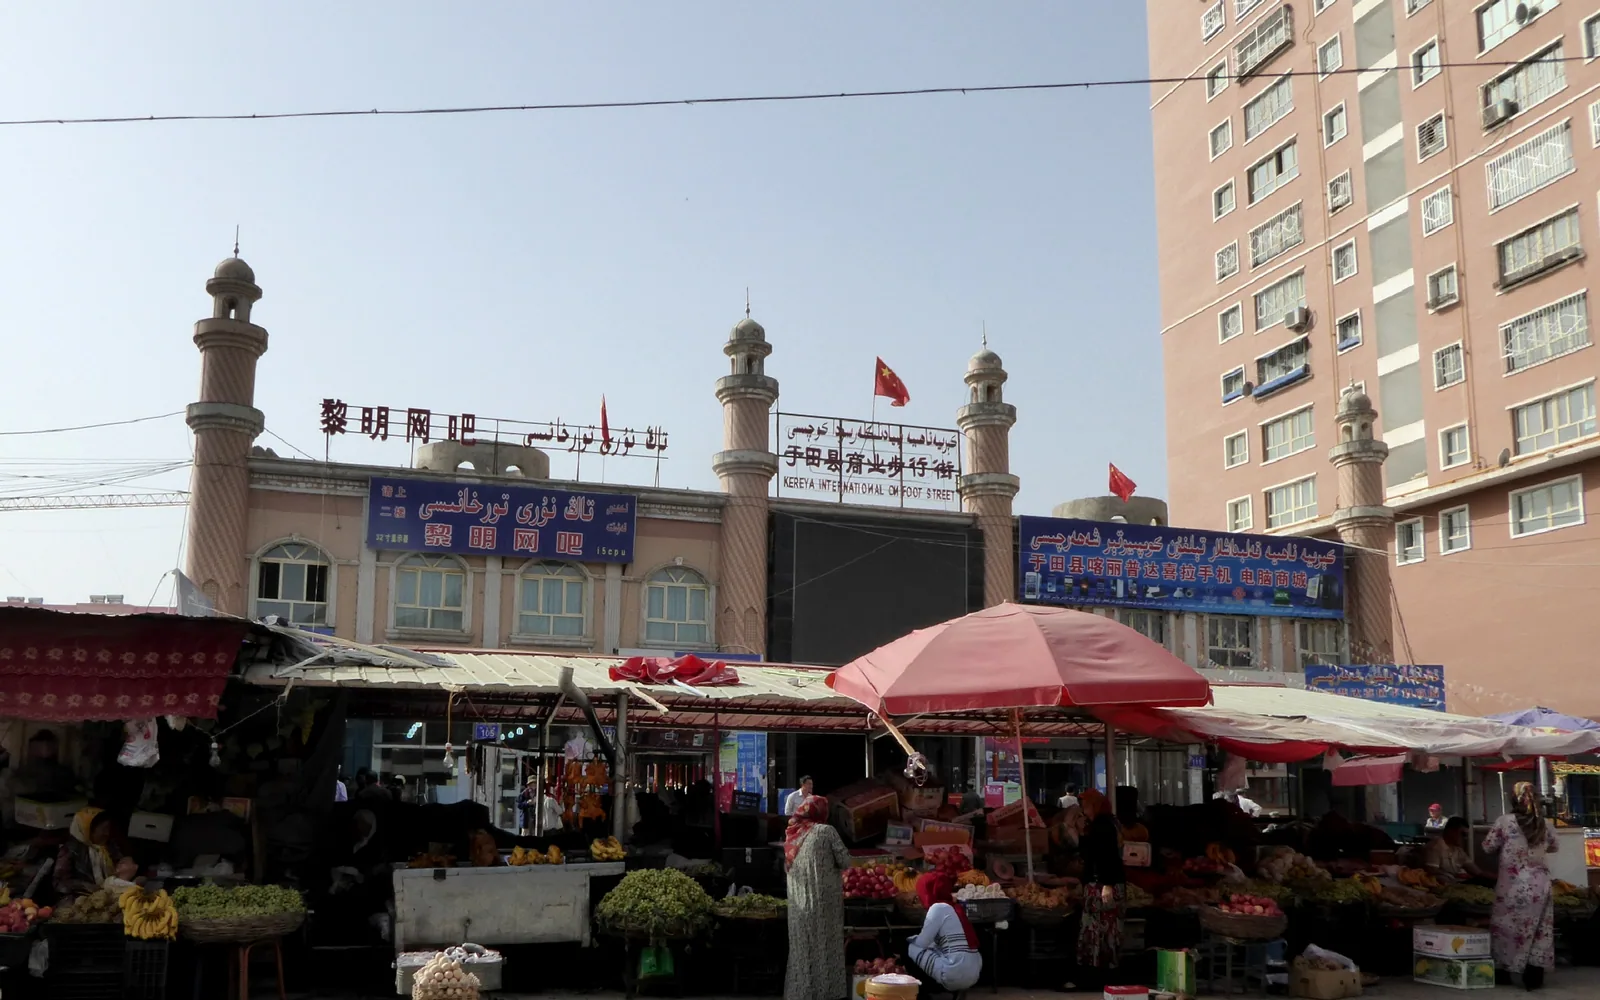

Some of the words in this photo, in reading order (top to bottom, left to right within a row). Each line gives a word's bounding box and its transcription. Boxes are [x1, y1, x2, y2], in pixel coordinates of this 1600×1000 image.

[321, 398, 476, 446] 黎明网吧
[784, 445, 955, 480] 于田县商业步行街
[419, 487, 510, 525] تورخانىسى
[783, 476, 815, 490] KEREYA
[819, 478, 884, 496] INTERNATIONAL
[902, 486, 922, 498] FOOT
[926, 488, 955, 502] STREET
[425, 523, 583, 556] 黎明网吧
[1029, 553, 1232, 584] 于田县喀丽普达喜拉手机
[1240, 567, 1308, 589] 电脑商城
